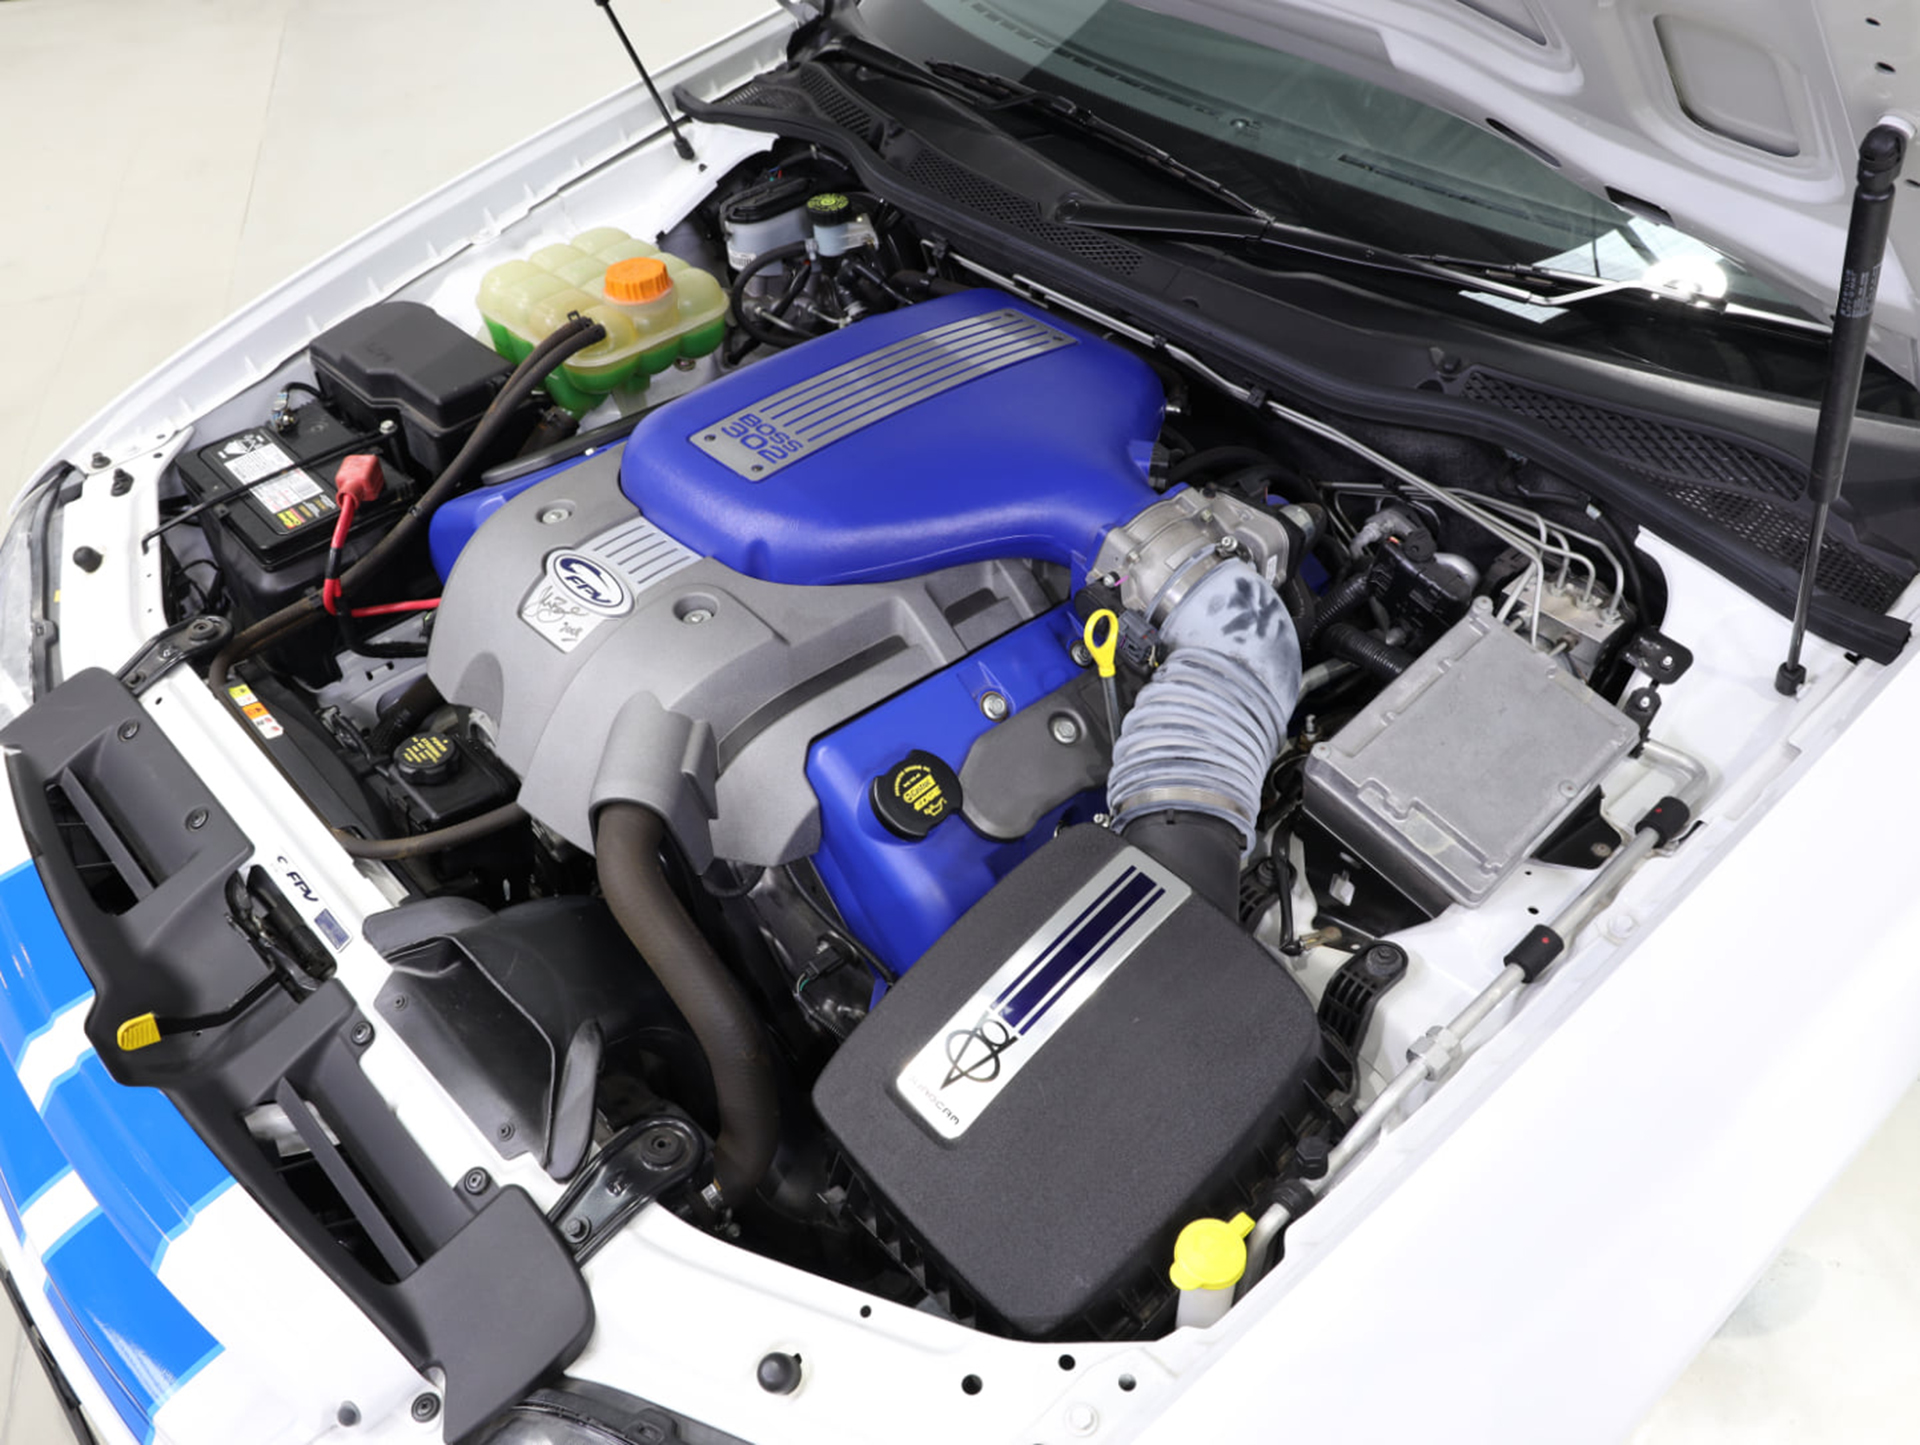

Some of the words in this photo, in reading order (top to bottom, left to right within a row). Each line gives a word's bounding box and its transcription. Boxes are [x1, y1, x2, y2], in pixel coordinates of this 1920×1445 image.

[721, 421, 789, 464] 302
[738, 413, 804, 453] BOSS
[564, 575, 612, 603] FPV
[286, 871, 319, 902] FPV
